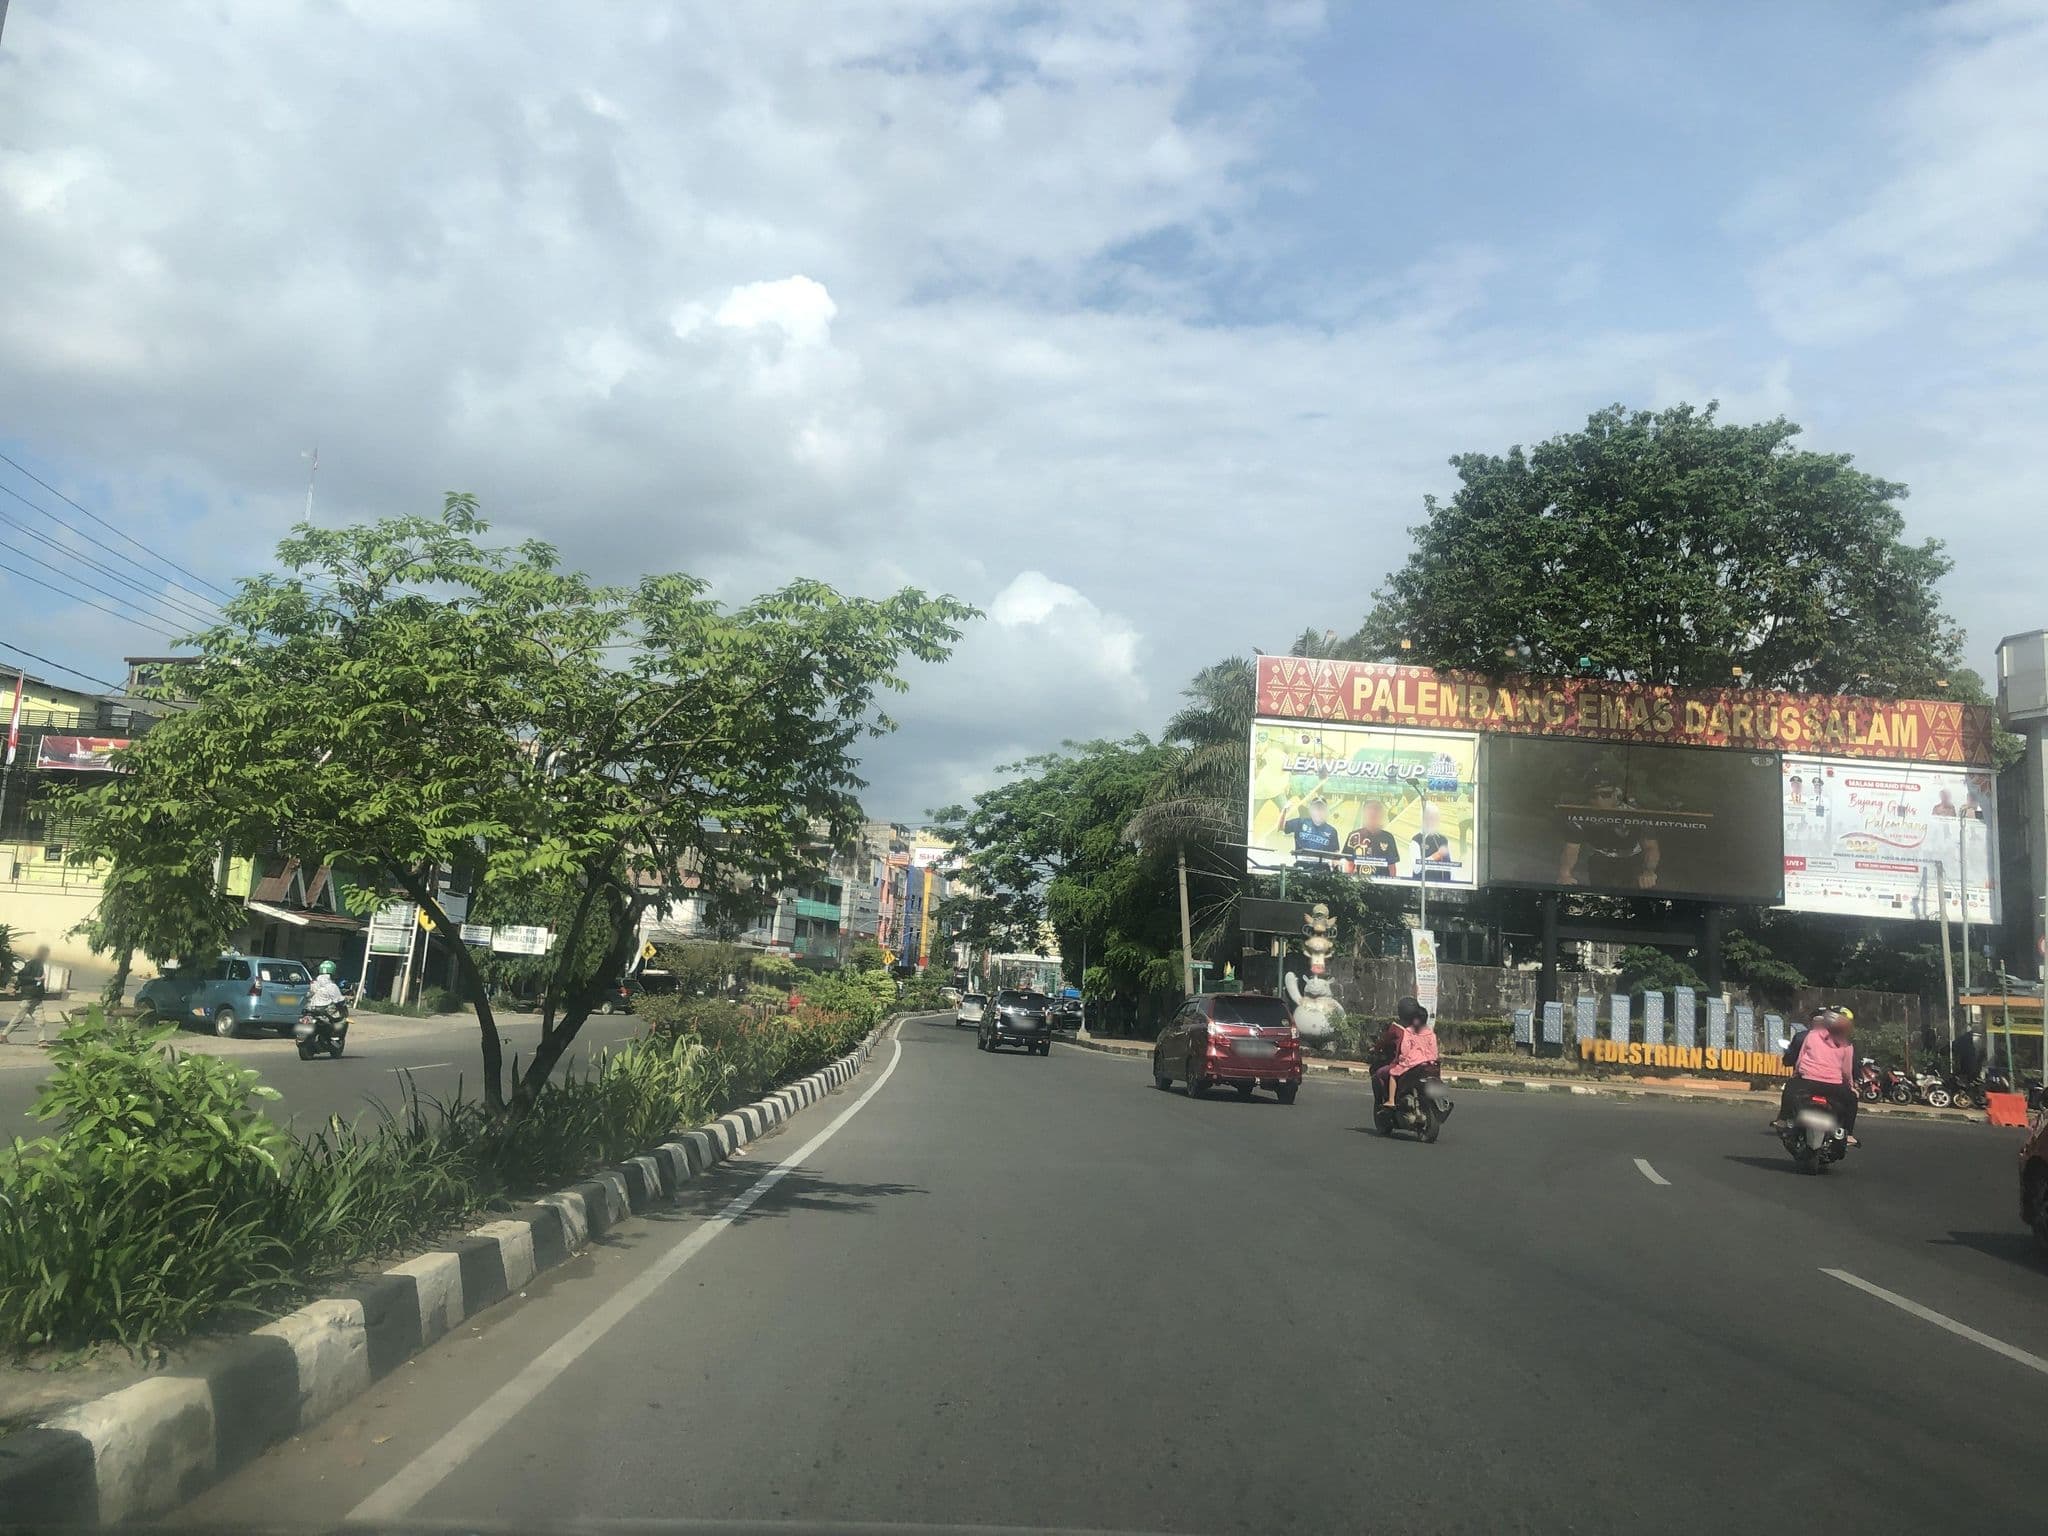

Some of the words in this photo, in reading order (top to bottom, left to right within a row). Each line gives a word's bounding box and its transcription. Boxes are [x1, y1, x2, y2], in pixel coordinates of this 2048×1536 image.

[1353, 676, 1566, 726] PALEMBANG
[1579, 693, 1674, 733] EMAS
[1685, 700, 1919, 748] DARUSSALAM
[1384, 763, 1426, 779] CUP
[1848, 779, 1875, 788] MALAM
[1875, 781, 1900, 790] GRAND
[1887, 799, 1919, 816] Gdis
[1580, 1037, 1703, 1069] PEDESTRIAN
